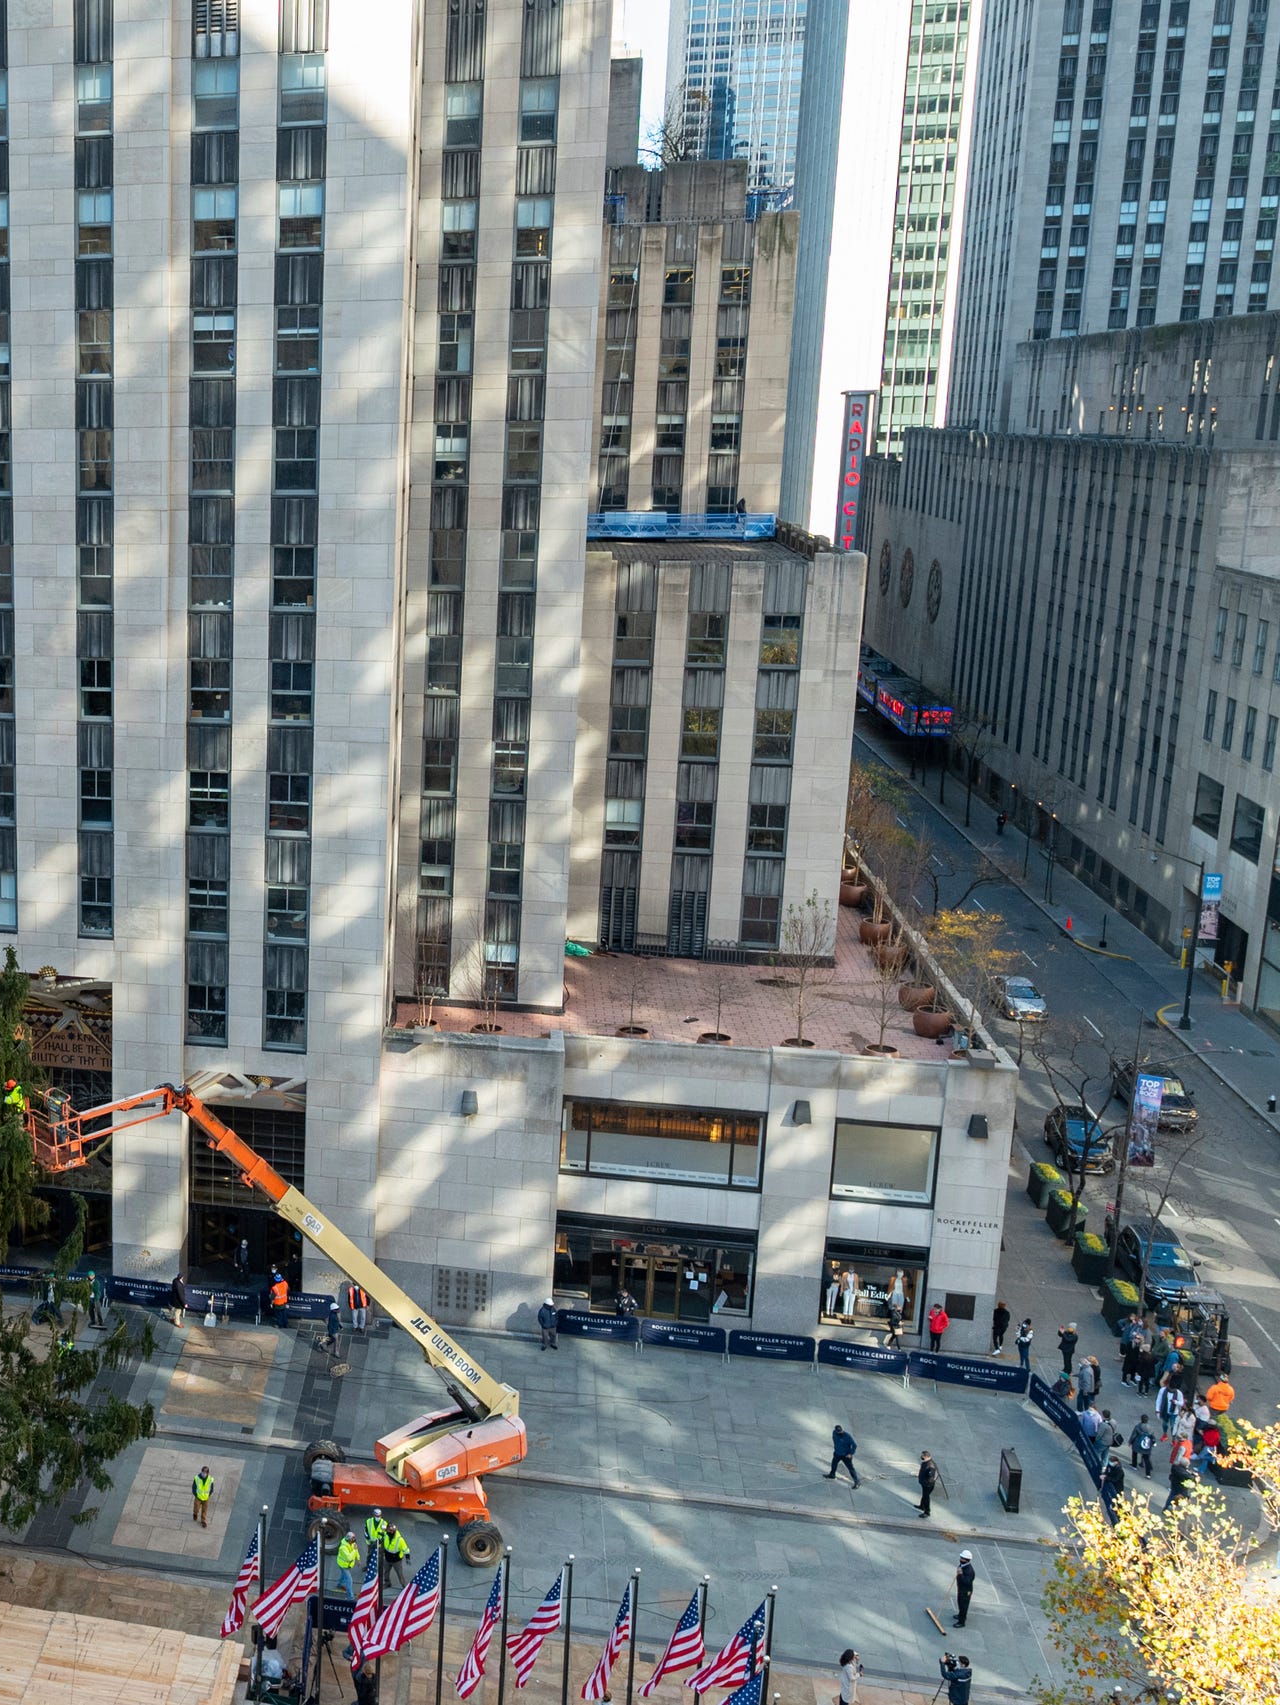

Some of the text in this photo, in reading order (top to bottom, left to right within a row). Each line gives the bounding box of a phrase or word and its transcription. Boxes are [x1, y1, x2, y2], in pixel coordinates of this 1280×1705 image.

[841, 403, 864, 550] RADIO CIT
[44, 1042, 100, 1055] SHALL BE THE
[32, 1052, 59, 1063] BILITY
[61, 1055, 75, 1064] OF
[77, 1056, 97, 1066] THY
[1140, 1079, 1160, 1088] TOP
[1139, 1090, 1158, 1098] ROCK
[937, 1218, 999, 1229] ROCKEFELLER
[953, 1227, 982, 1235] PLAZA
[566, 1315, 605, 1324] ROCKEFELLER
[651, 1324, 691, 1334] ROCKEFELLER
[739, 1335, 780, 1344] ROCKEFELLER
[410, 1317, 482, 1385] JLG ULTRA BOOM
[829, 1345, 897, 1360] ROCKEFELLER CENTER
[946, 1363, 1016, 1377] ROCKEFELLER CENTER
[437, 1464, 458, 1480] GAR
[323, 1604, 354, 1614] OCKEFEL
